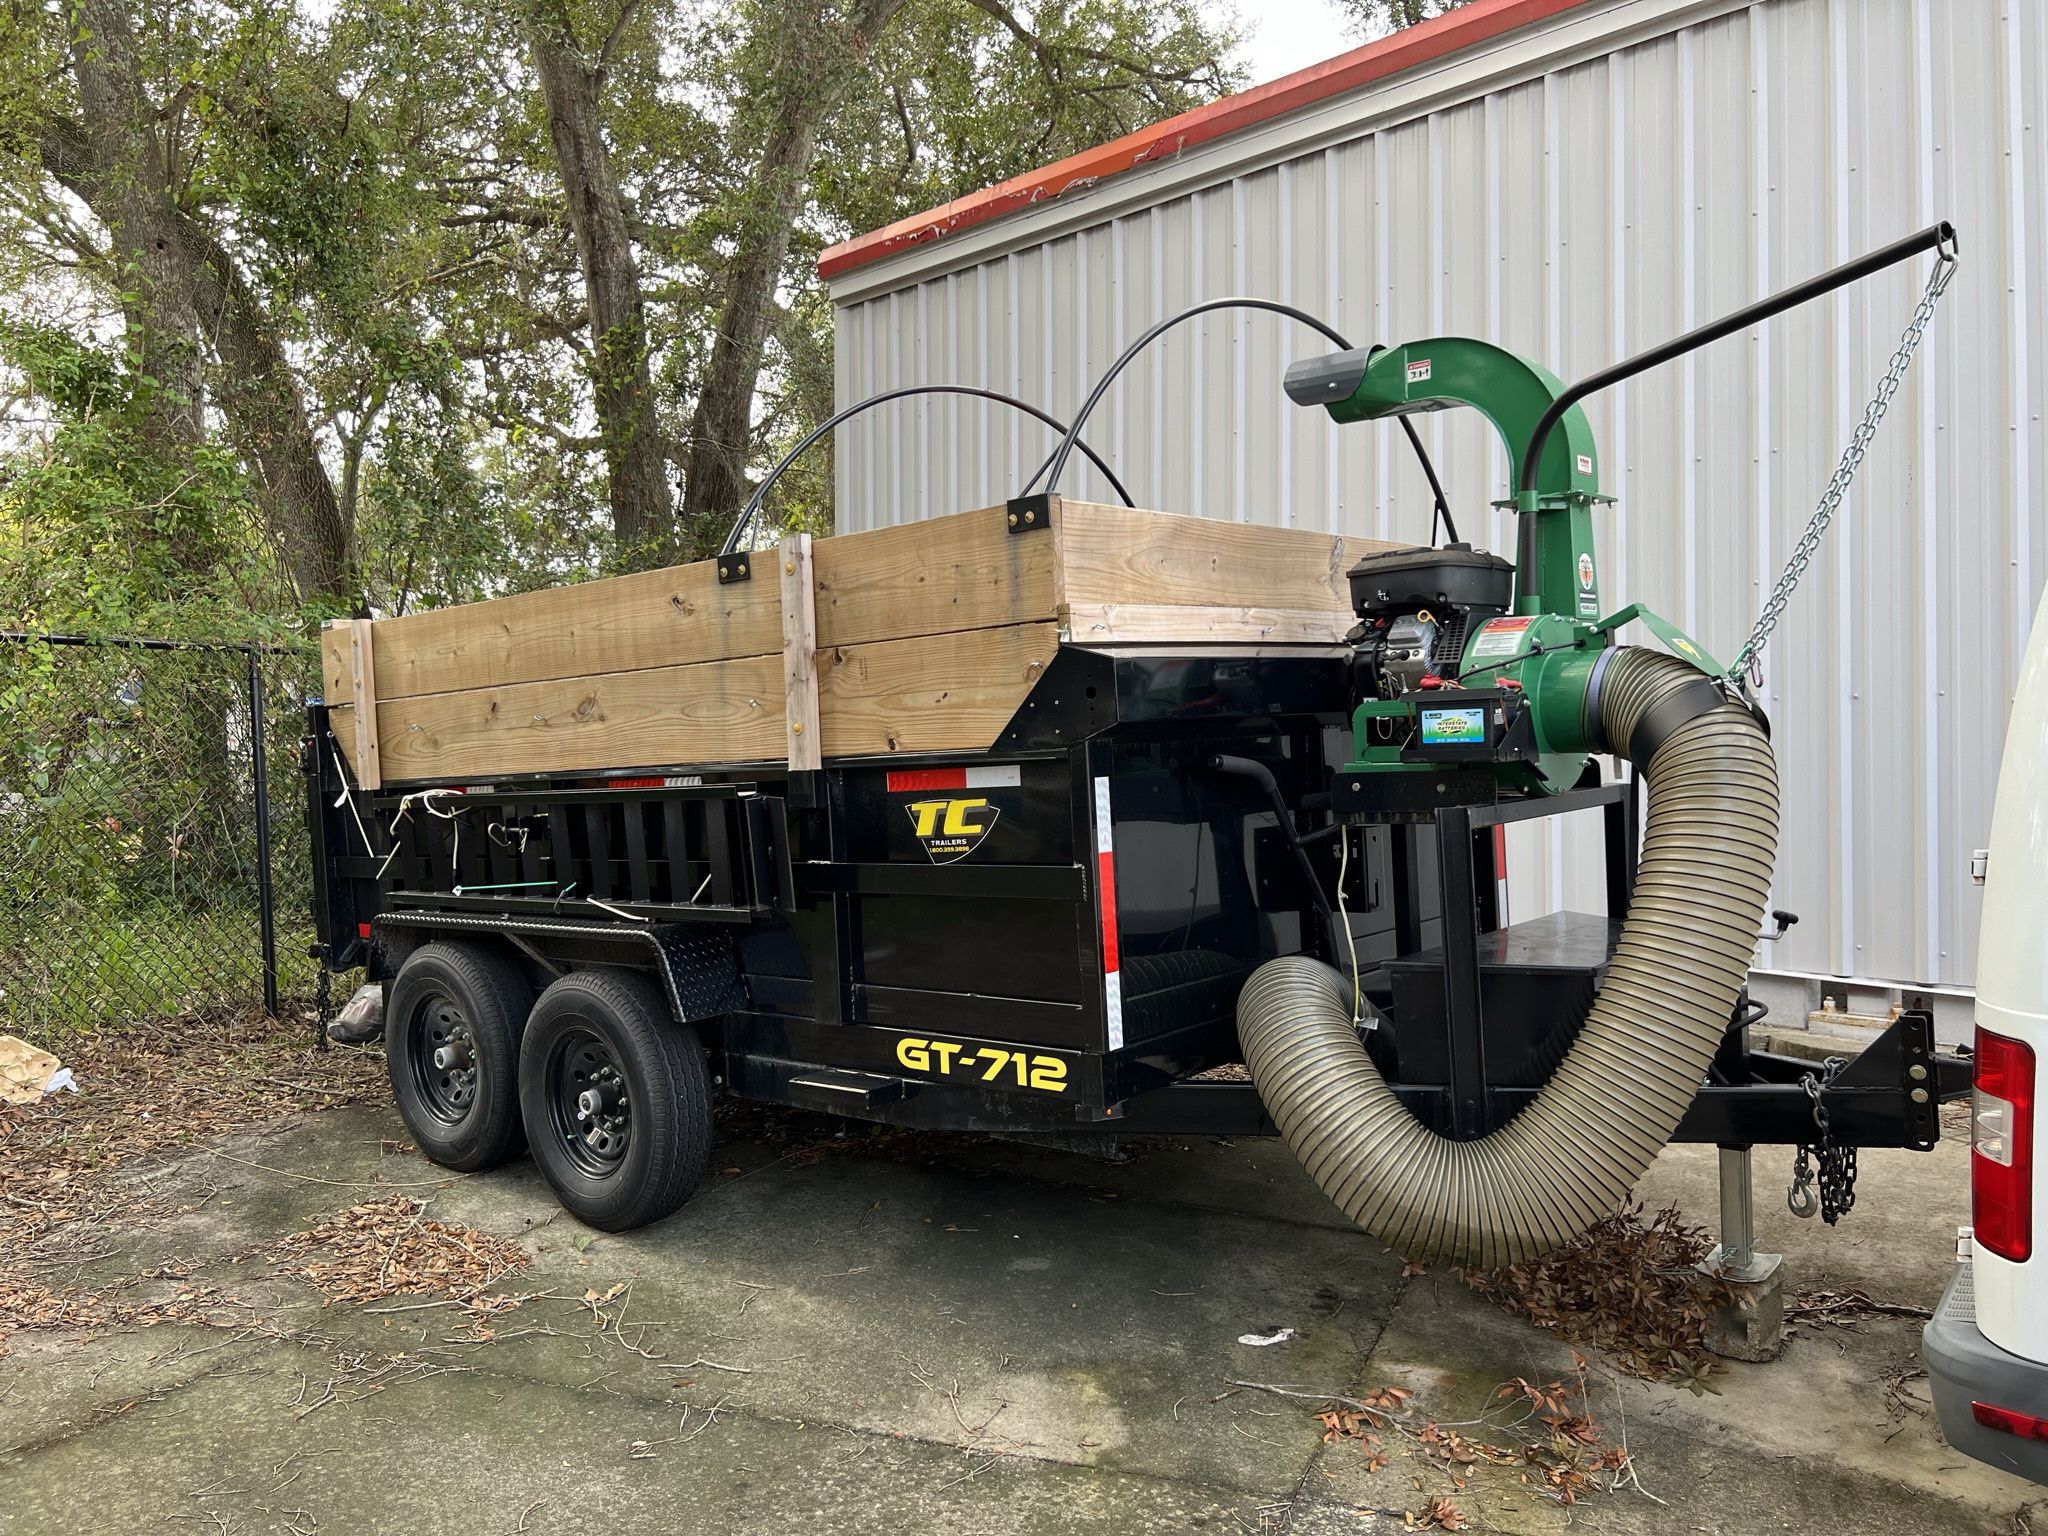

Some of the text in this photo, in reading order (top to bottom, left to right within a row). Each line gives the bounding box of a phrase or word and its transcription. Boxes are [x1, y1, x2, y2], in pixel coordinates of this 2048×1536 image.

[911, 798, 988, 838] TC
[930, 838, 967, 846] TRAILERS
[896, 1037, 1068, 1092] GT-712
